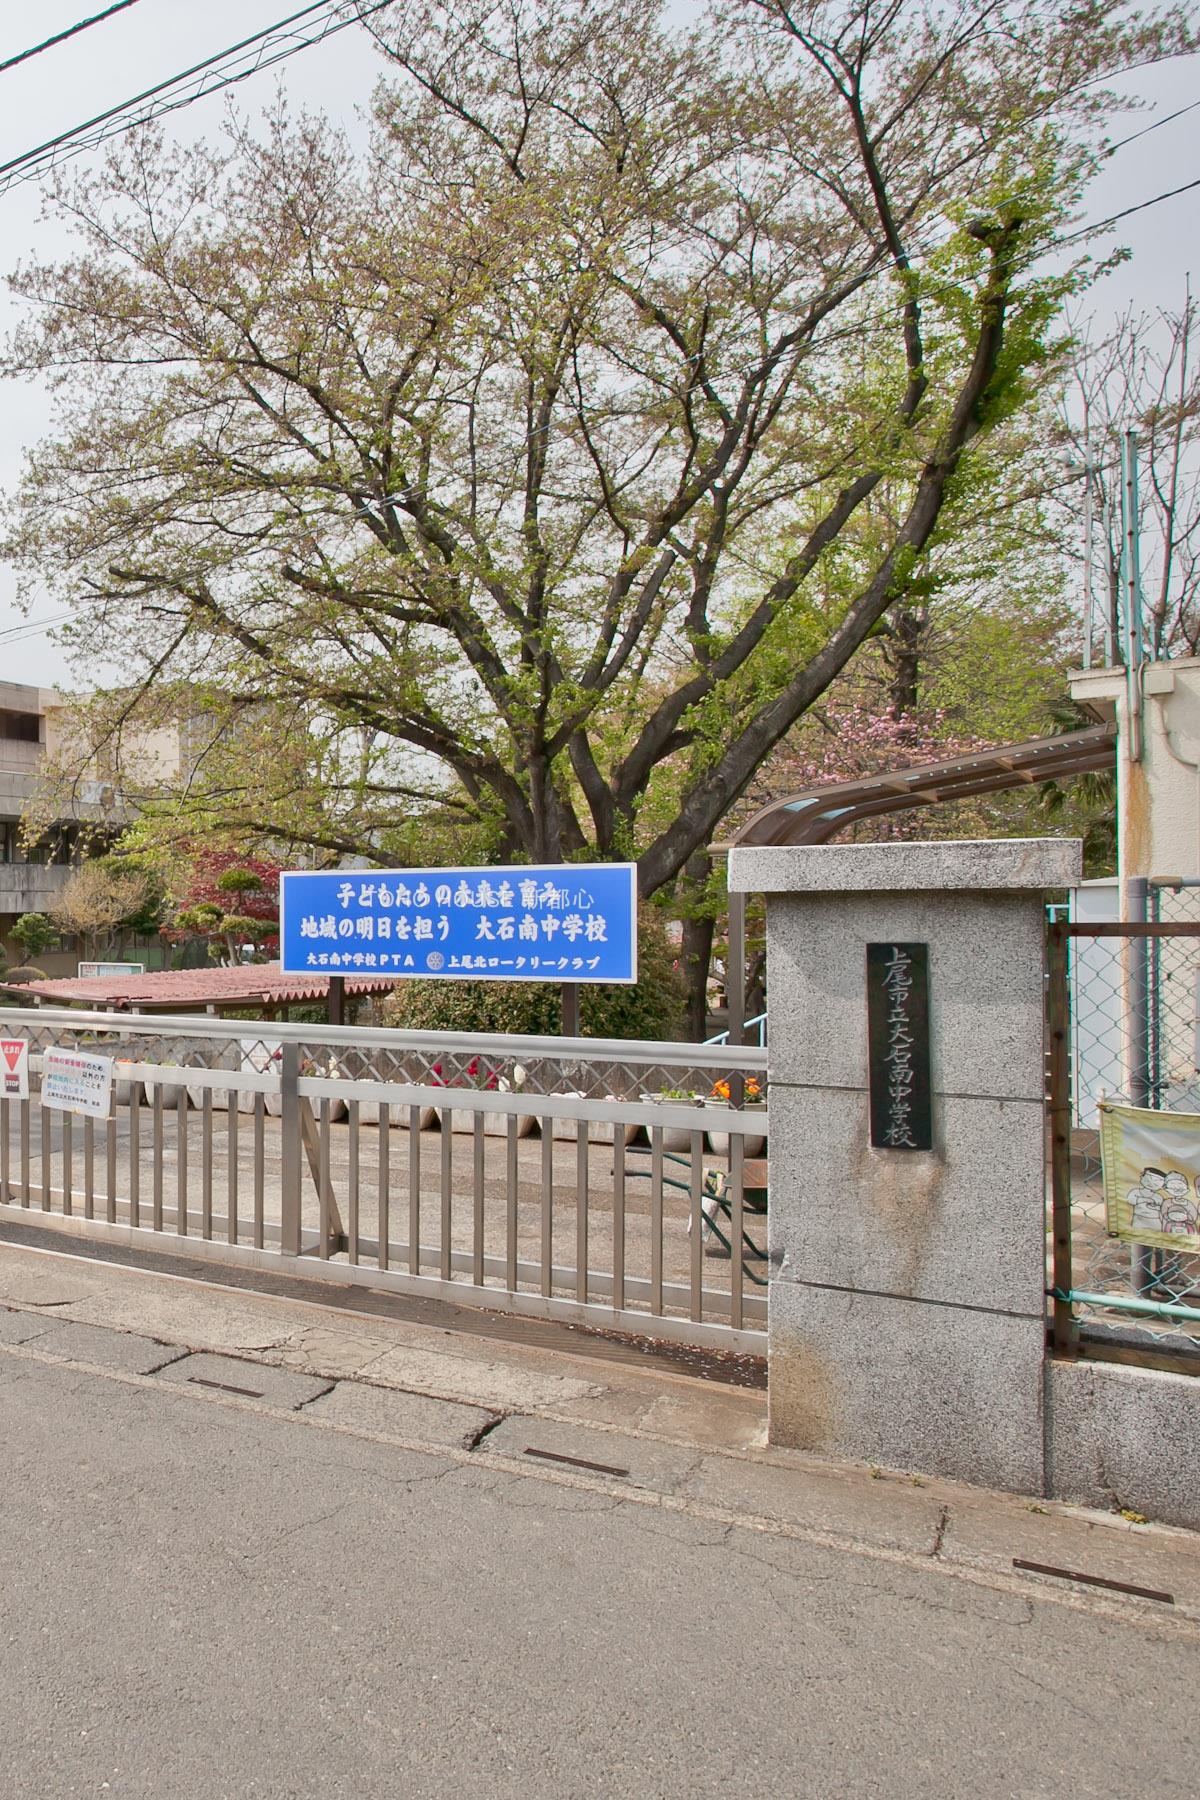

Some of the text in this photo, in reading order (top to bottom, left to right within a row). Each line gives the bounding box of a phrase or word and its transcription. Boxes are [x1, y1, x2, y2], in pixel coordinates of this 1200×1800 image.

[300, 913, 609, 943] 地域の明日を担う 大石南中学校
[447, 954, 601, 971] 上尾北ロータリークラブ
[4, 1045, 19, 1054] 止まれ
[881, 946, 918, 1148] 上尾市立大石南中学校
